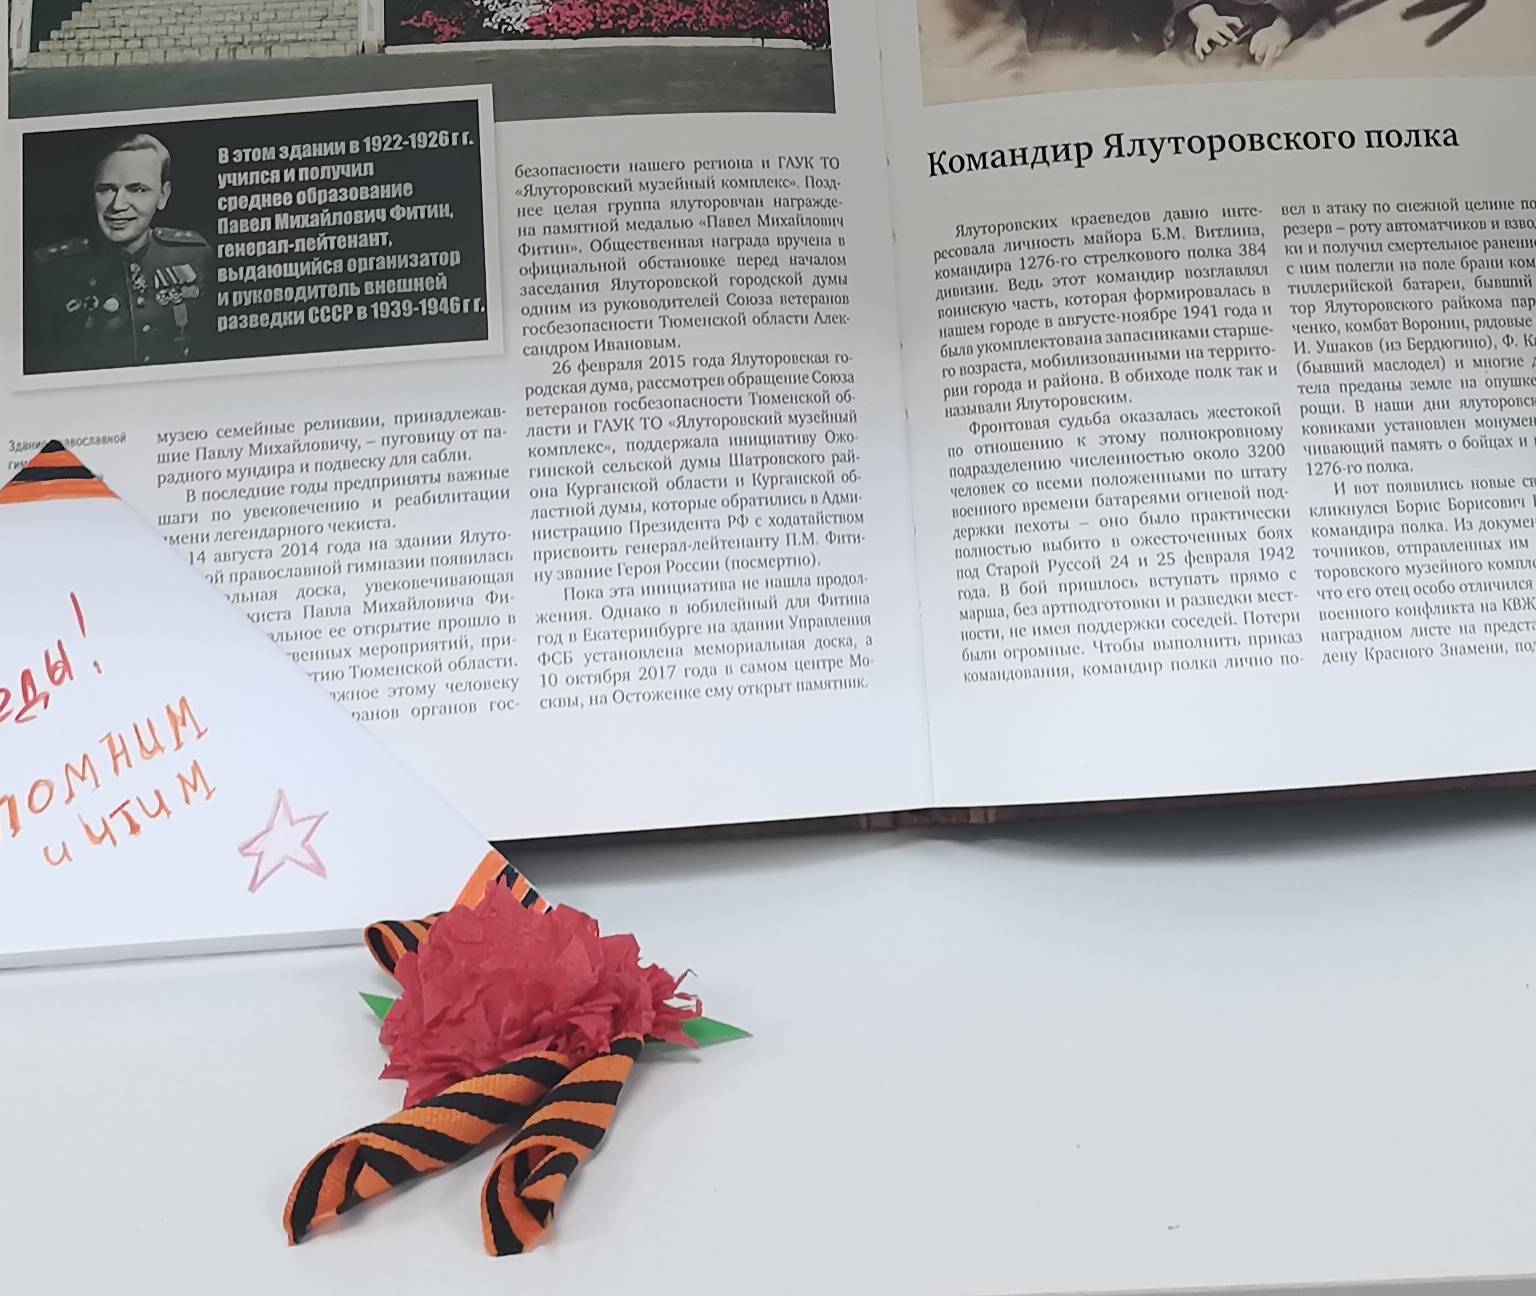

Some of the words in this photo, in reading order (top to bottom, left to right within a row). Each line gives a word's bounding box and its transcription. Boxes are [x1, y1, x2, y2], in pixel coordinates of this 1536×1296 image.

[218, 147, 229, 164] В
[232, 147, 276, 164] этом
[278, 142, 346, 162] здании
[350, 140, 360, 154] в
[363, 129, 449, 153] 1922-1926
[926, 138, 1094, 178] Командир
[1102, 125, 1357, 162] Ялуторовского
[1364, 123, 1459, 150] полка
[218, 169, 281, 189] учился
[283, 168, 296, 183] и
[298, 161, 374, 182] получил
[514, 161, 620, 179] безопасности
[628, 159, 685, 175] нашего
[693, 157, 754, 175] региона
[777, 156, 814, 170] ГАУК
[820, 156, 840, 170] ТО
[218, 190, 293, 212] среднее
[296, 182, 413, 205] образование
[217, 214, 271, 235] Павел
[274, 208, 387, 231] Михайлович
[389, 203, 454, 221] Фитин,
[955, 217, 1058, 239] Ялуторовских
[1071, 210, 1151, 228] краеведов
[1163, 207, 1209, 222] давно
[217, 231, 393, 258] генерал-лейтенант,
[217, 257, 343, 283] выдающийся
[347, 250, 461, 274] организатор
[217, 291, 229, 306] и
[232, 282, 361, 307] руководитель
[364, 272, 448, 296] внешней
[217, 309, 305, 333] разведки
[308, 304, 354, 324] СССР
[356, 306, 367, 320] в
[370, 296, 461, 320] 1939-1946
[552, 361, 571, 375] 26
[577, 358, 643, 377] февраля
[649, 355, 686, 370] 2015
[693, 355, 725, 370] года
[731, 352, 830, 369] Ялуторовская
[157, 429, 208, 445] музею
[216, 422, 295, 440] семейные
[303, 414, 385, 436] реликвии,
[1364, 644, 1434, 662] Красного
